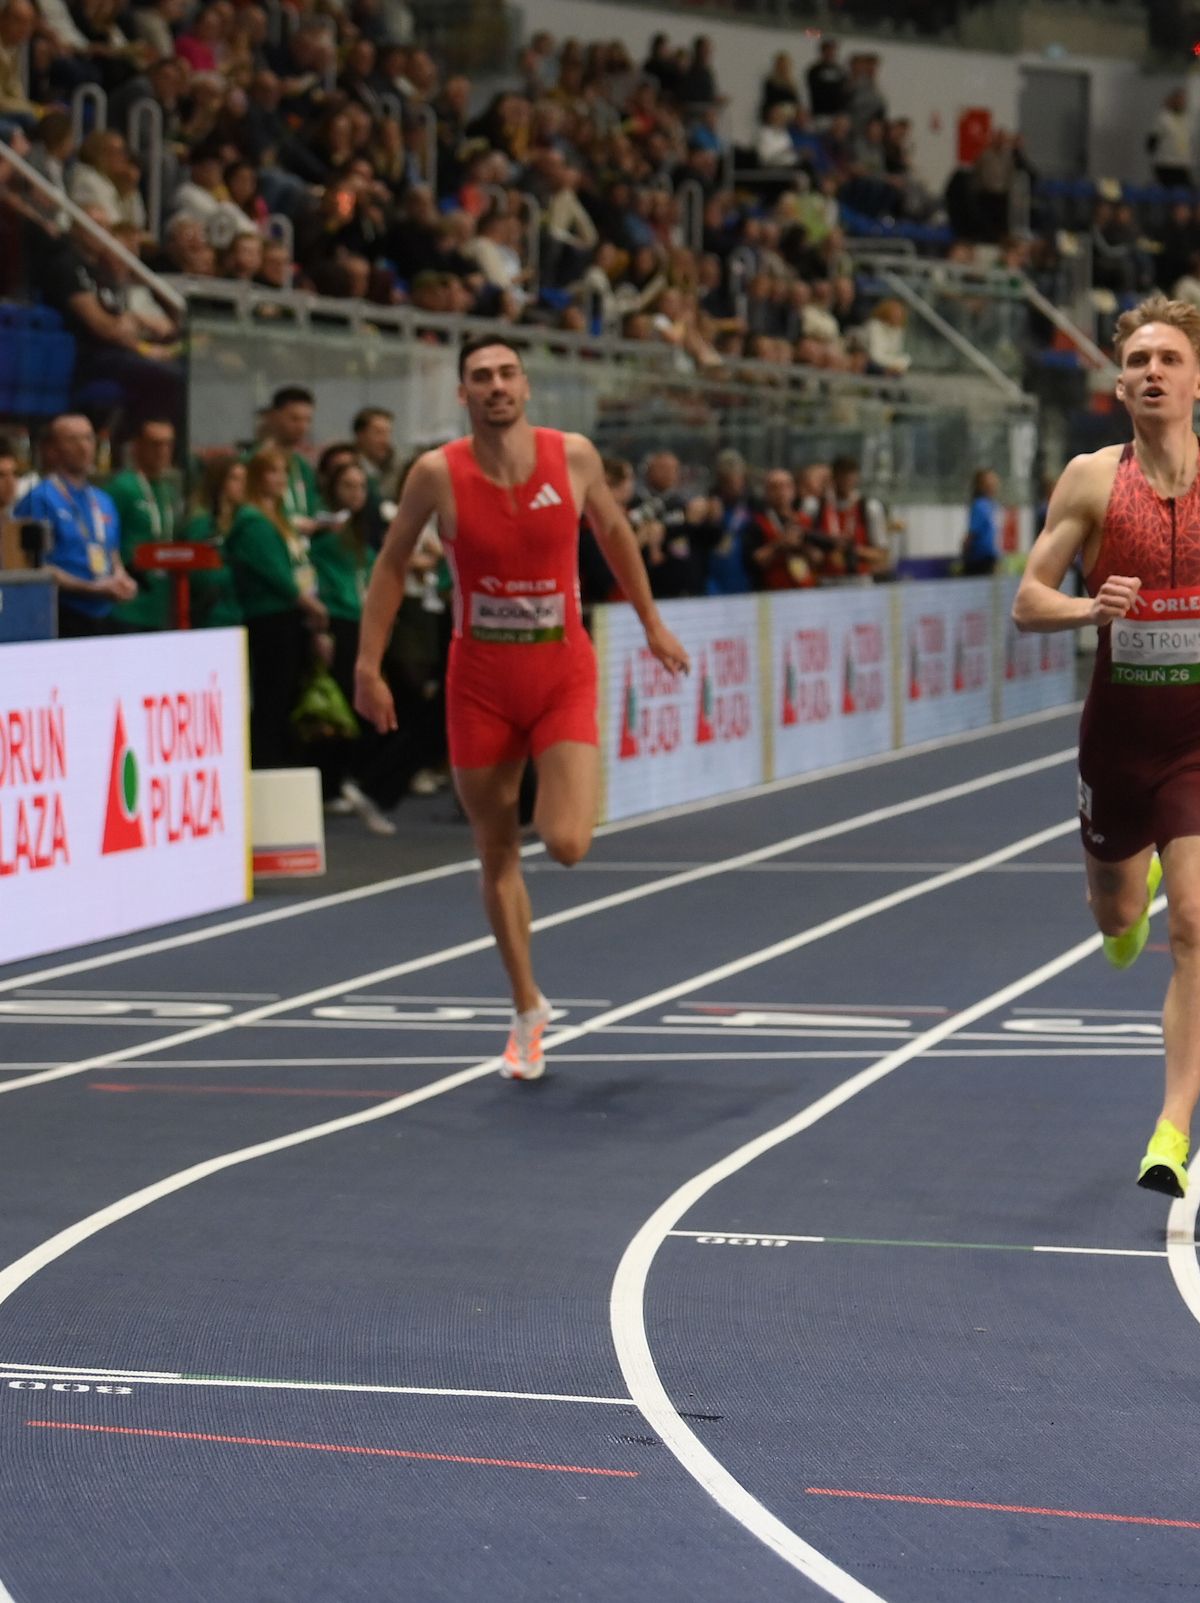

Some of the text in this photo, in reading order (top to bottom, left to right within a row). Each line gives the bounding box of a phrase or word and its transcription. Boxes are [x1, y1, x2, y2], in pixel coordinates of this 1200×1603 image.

[1116, 666, 1190, 682] TORUŃ 26
[143, 671, 223, 766] TORUŃ
[150, 769, 224, 846] PLAZA
[8, 1380, 133, 1395] 800
